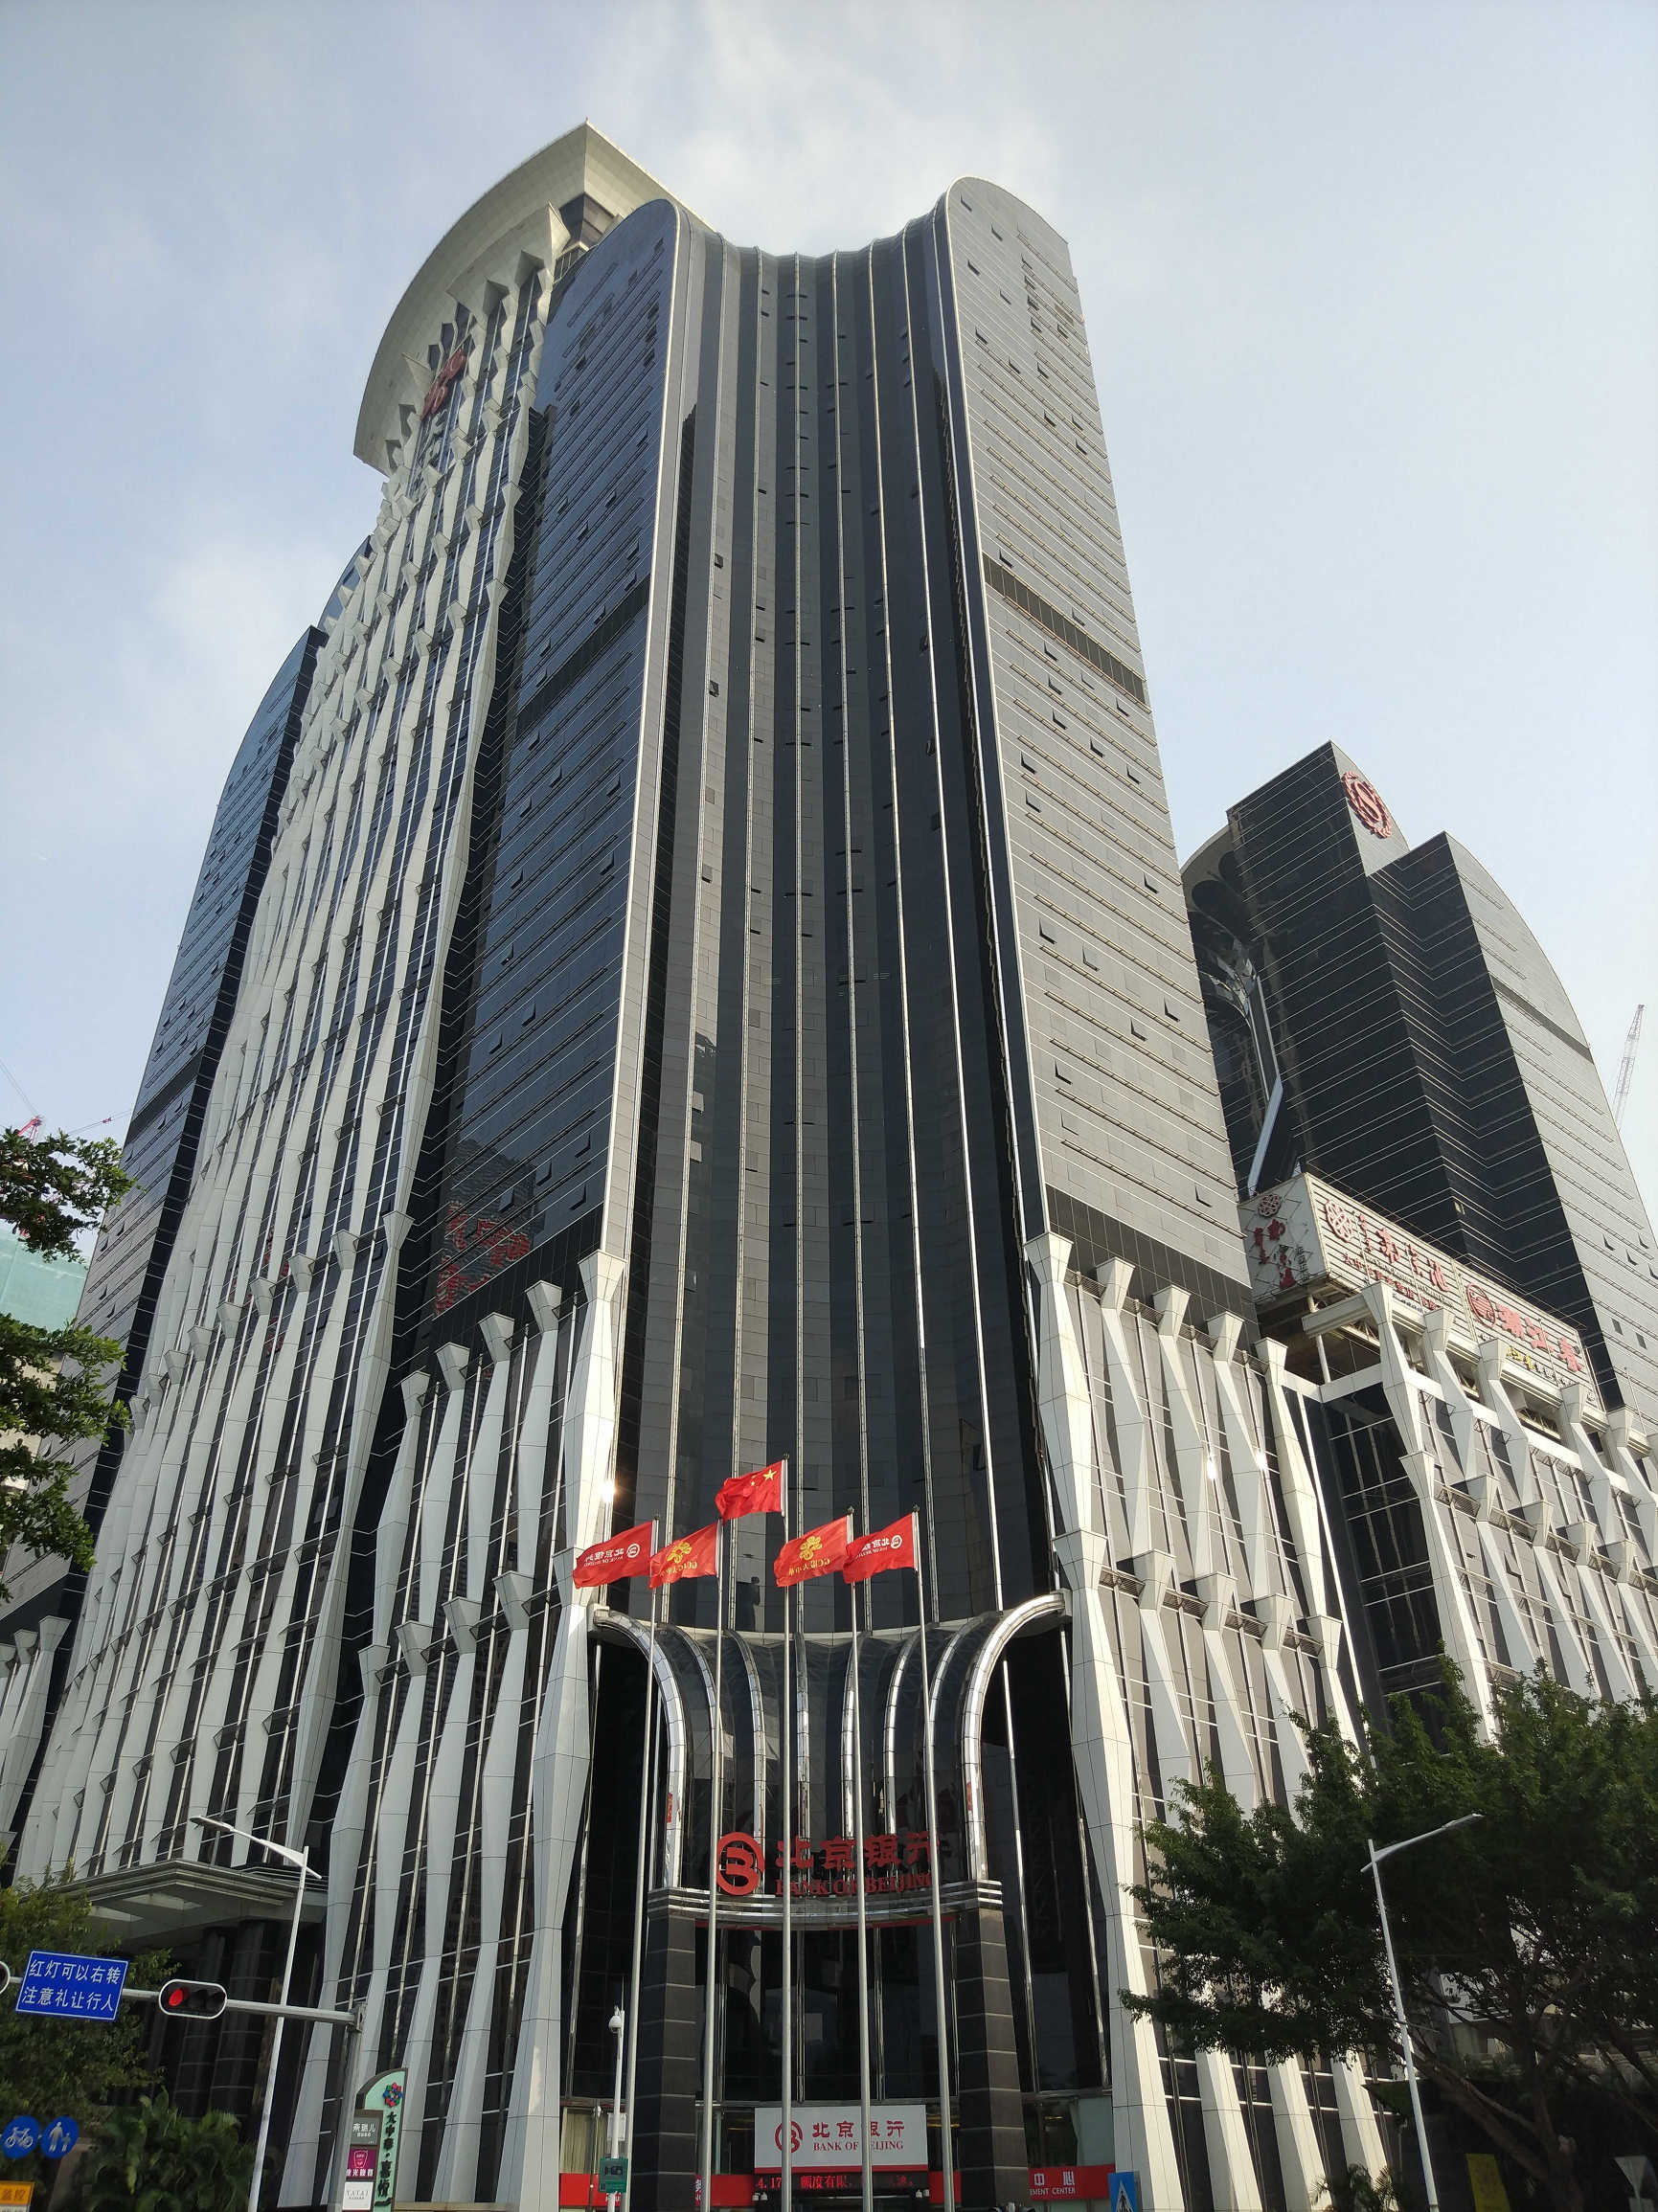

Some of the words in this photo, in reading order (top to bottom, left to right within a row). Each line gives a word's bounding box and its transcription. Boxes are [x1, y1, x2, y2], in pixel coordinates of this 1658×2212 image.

[775, 1831, 940, 1870] 北京银行
[28, 1959, 122, 1984] 红灯可以右转
[21, 1986, 113, 2012] 注意礼让行人
[813, 2141, 842, 2152] BANK
[845, 2141, 859, 2151] OF
[870, 2140, 904, 2151] EIJING
